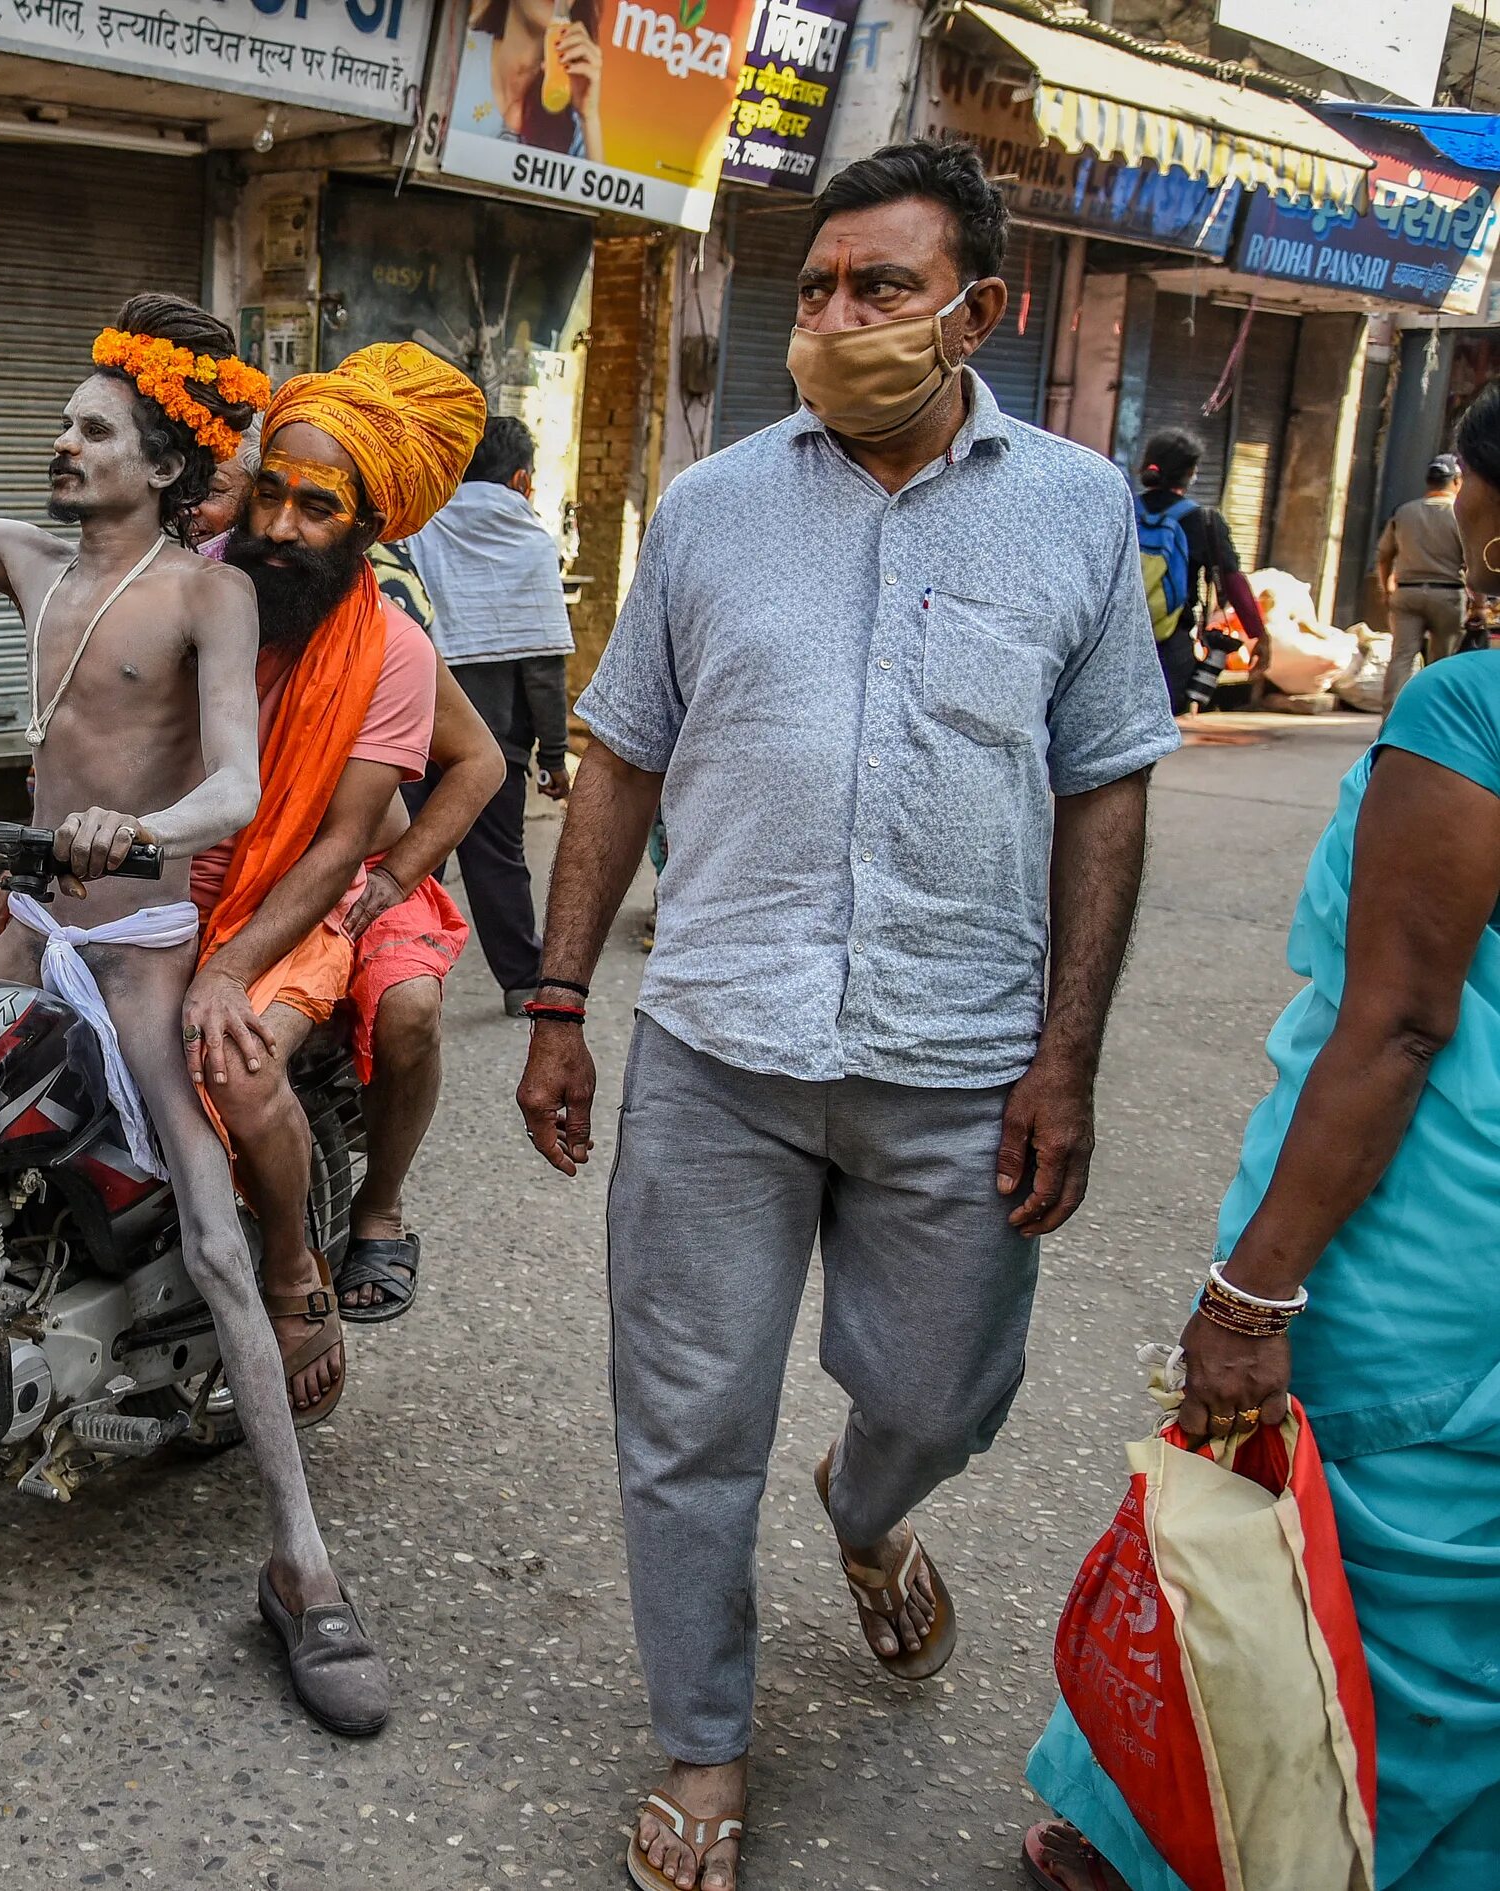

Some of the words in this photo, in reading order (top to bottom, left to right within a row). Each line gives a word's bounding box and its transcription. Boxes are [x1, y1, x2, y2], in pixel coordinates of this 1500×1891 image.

[179, 16, 245, 63] उचित
[249, 36, 296, 77] मूल्य
[301, 47, 327, 80] पर
[331, 46, 389, 91] मिलता
[612, 1, 732, 79] maaza
[512, 153, 575, 192] SHIV
[580, 170, 646, 211] SODA
[1372, 168, 1497, 257] पंसारी
[1246, 233, 1314, 279] RODHA
[1314, 246, 1391, 291] PANSARI
